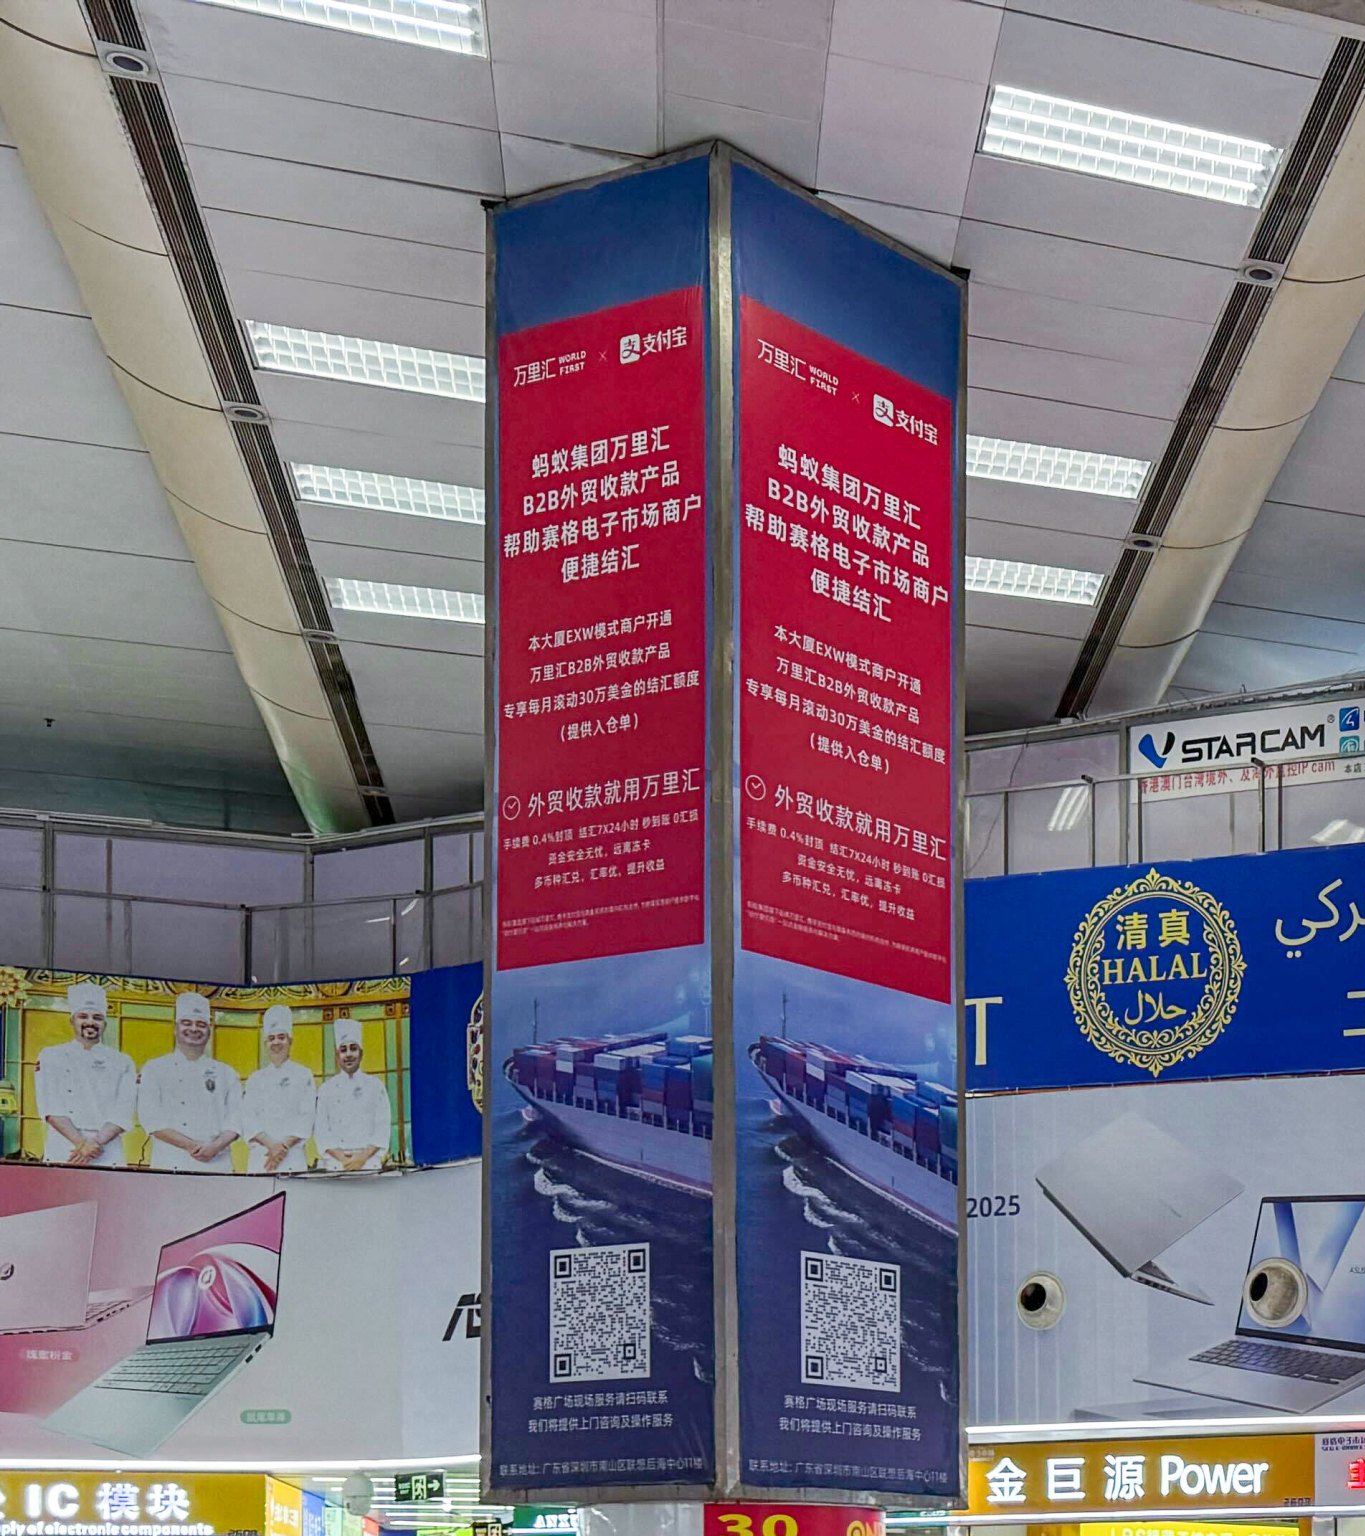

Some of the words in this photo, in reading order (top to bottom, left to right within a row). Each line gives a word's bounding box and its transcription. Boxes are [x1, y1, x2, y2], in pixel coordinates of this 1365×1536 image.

[513, 358, 556, 387] 万里汇
[558, 350, 586, 364] WORLD
[559, 362, 585, 375] FIRST
[757, 338, 806, 381] 万里汇
[809, 365, 839, 385] WORLD
[810, 377, 837, 396] FIRST
[531, 425, 670, 479] 蚂蚁集团万里汇
[523, 460, 680, 516] B2B外贸收款产品
[778, 444, 921, 530] 蚂蚁集团万里汇
[503, 494, 702, 557] 帮助赛格电子市场商户
[768, 478, 929, 568] B2B外贸收款产品
[561, 544, 640, 583] 便捷结汇
[745, 504, 948, 607] 帮助赛格电子市场商户
[811, 568, 892, 622] 便捷结汇
[528, 609, 673, 651] 本大厦EXW模式商户开通
[530, 643, 671, 683] 万里汇B2B外贸收款产品
[774, 625, 921, 695] 本大厦EXW模式商户开通
[504, 669, 700, 719] 专享每月滚动30万美金的结汇额度
[776, 657, 919, 724] 万里汇B2B外贸收款产品
[746, 679, 946, 765] 专享每月滚动30万美金的结汇额度
[1181, 724, 1325, 763] STARCAM
[528, 768, 700, 817] 外贸收款就用万里汇
[775, 784, 946, 861] 外贸收款就用万里汇
[1115, 909, 1191, 951] 清真
[1101, 952, 1208, 984] HALAL
[1124, 990, 1188, 1024] حلال
[966, 1196, 1021, 1218] 2025
[532, 1390, 668, 1410] 赛格广场现场服务请扫码联系
[784, 1395, 917, 1418] 赛格广场现场服务请扫码联系
[528, 1413, 674, 1433] 我们将提供上门咨询及操作服务
[779, 1417, 922, 1441] 我们将提供上门咨询及操作服务
[986, 1454, 1145, 1503] 金巨源
[1160, 1454, 1269, 1496] Power
[25, 1484, 79, 1518] IC
[97, 1483, 190, 1521] 模块
